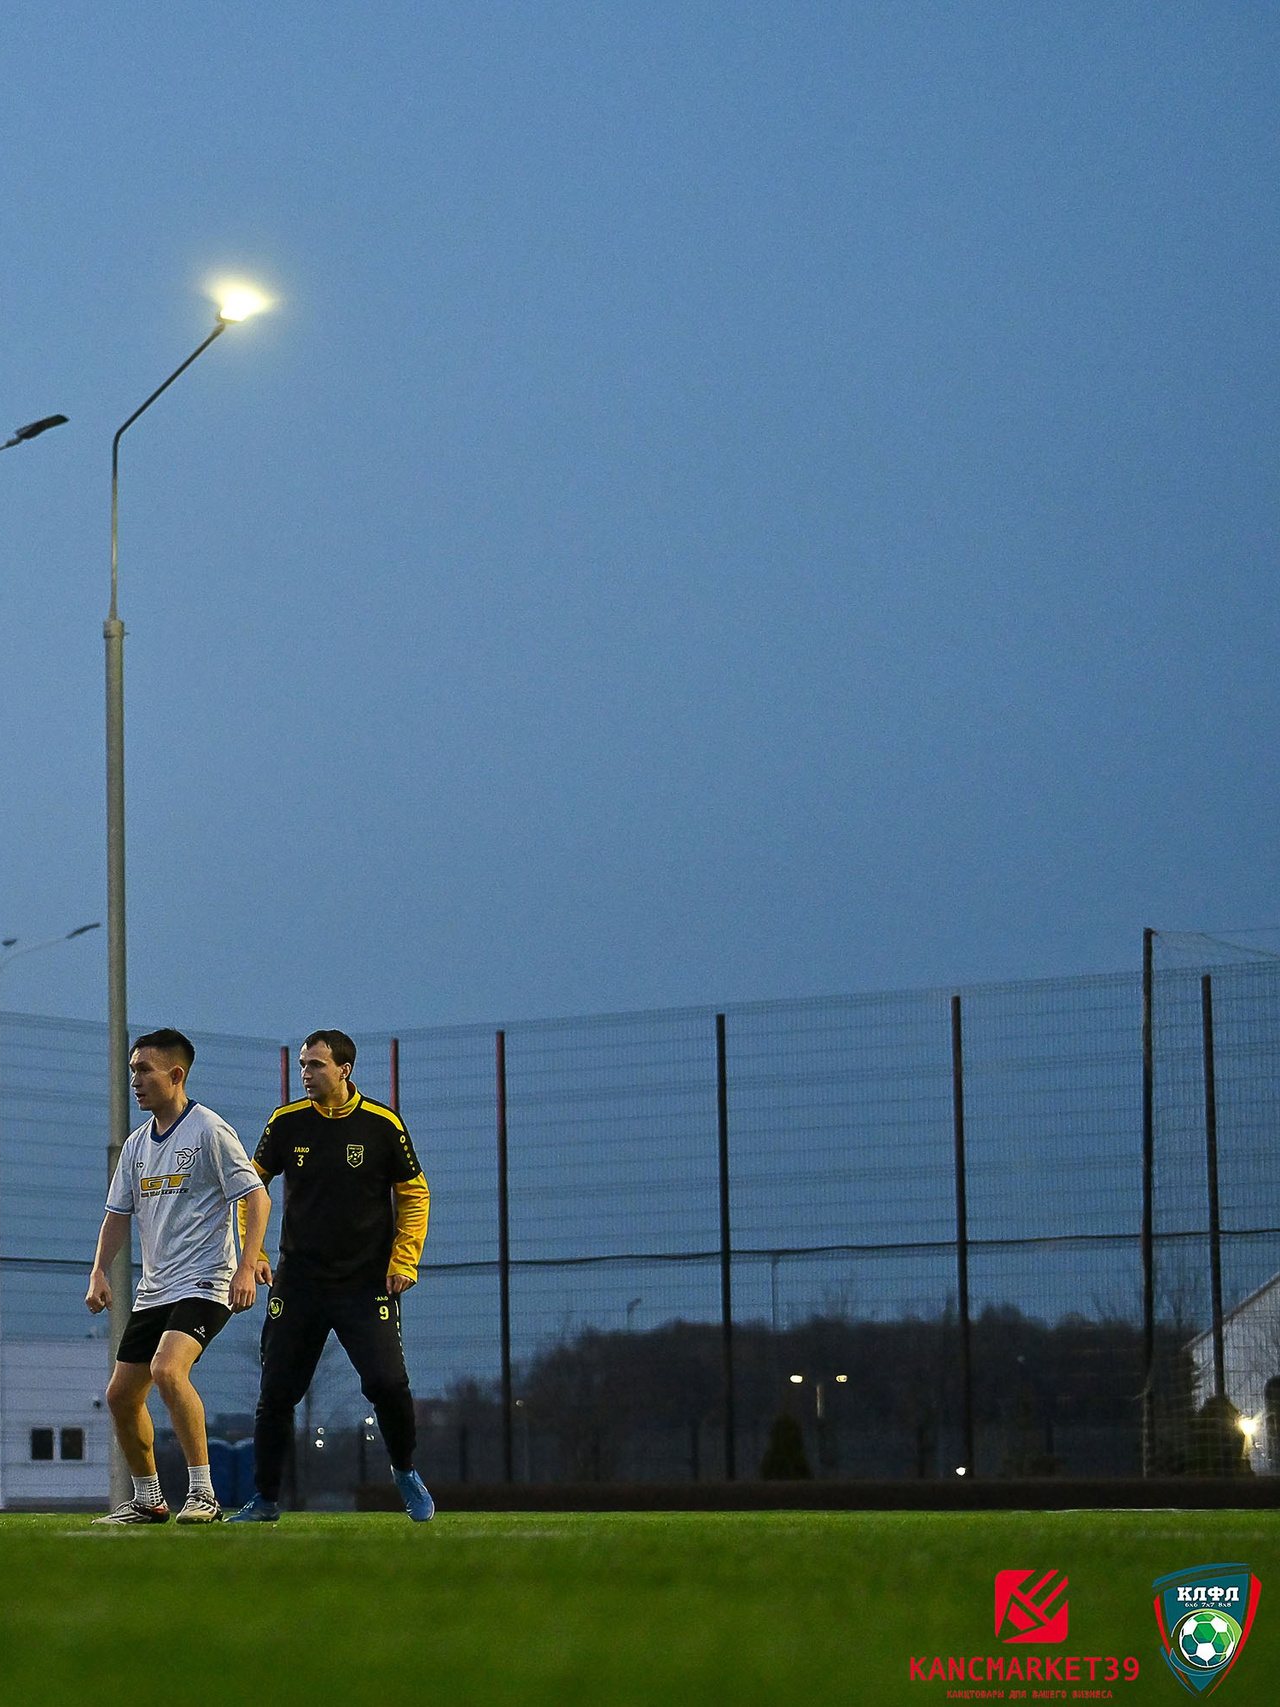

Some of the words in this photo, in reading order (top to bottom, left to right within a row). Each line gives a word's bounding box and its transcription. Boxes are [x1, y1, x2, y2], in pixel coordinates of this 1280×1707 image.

[297, 1154, 305, 1168] 3
[141, 1174, 191, 1191] GT
[379, 1305, 389, 1320] 9
